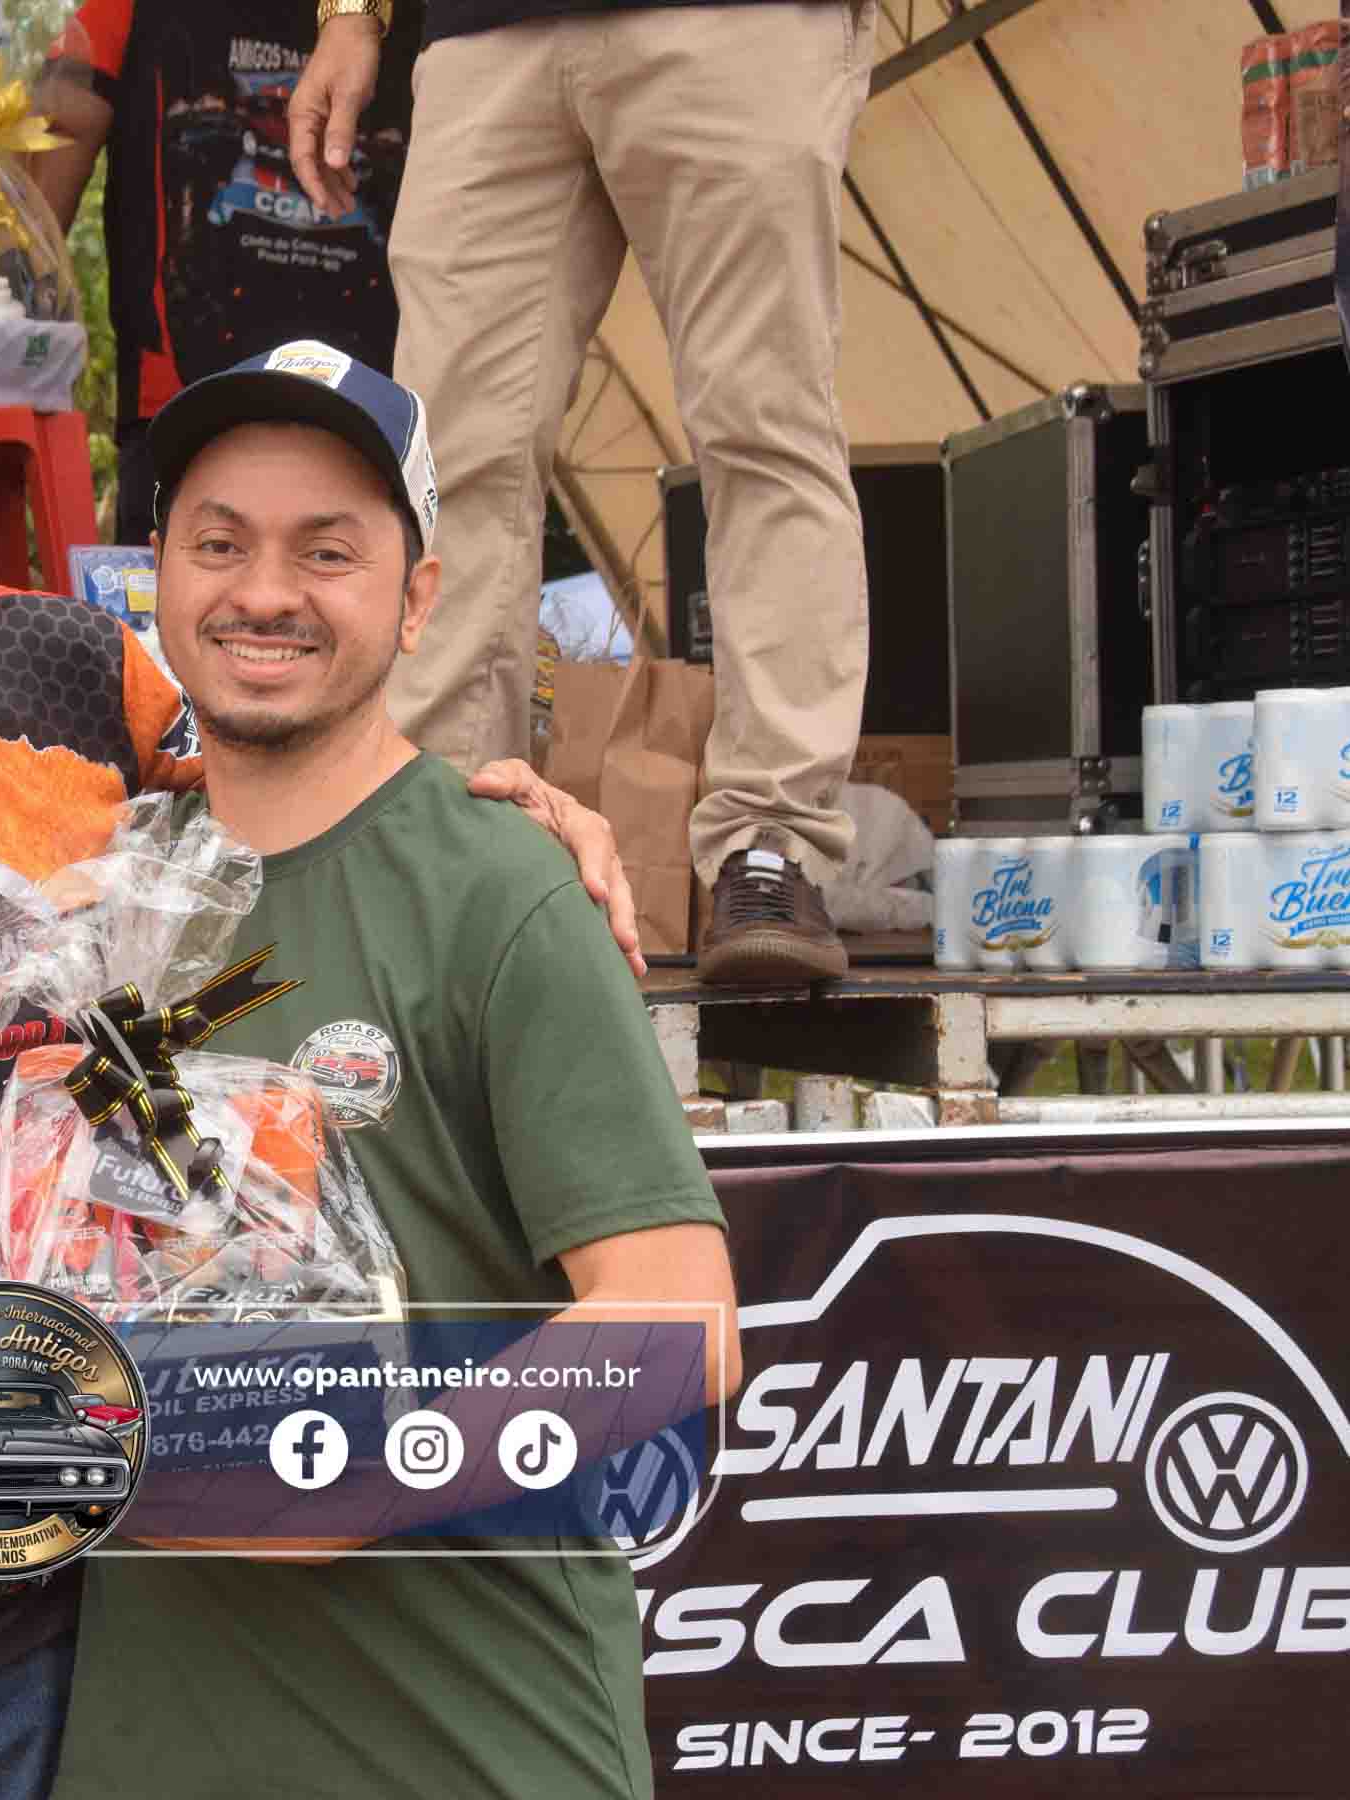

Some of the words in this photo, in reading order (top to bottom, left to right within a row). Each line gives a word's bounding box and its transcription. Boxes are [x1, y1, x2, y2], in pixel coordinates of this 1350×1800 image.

[1275, 790, 1299, 805] 12
[319, 1023, 363, 1038] ROTA
[365, 1027, 386, 1041] 67
[195, 1387, 308, 1414] EXPRESS
[635, 1576, 966, 1675] SCA
[958, 1708, 1150, 1758] 2012
